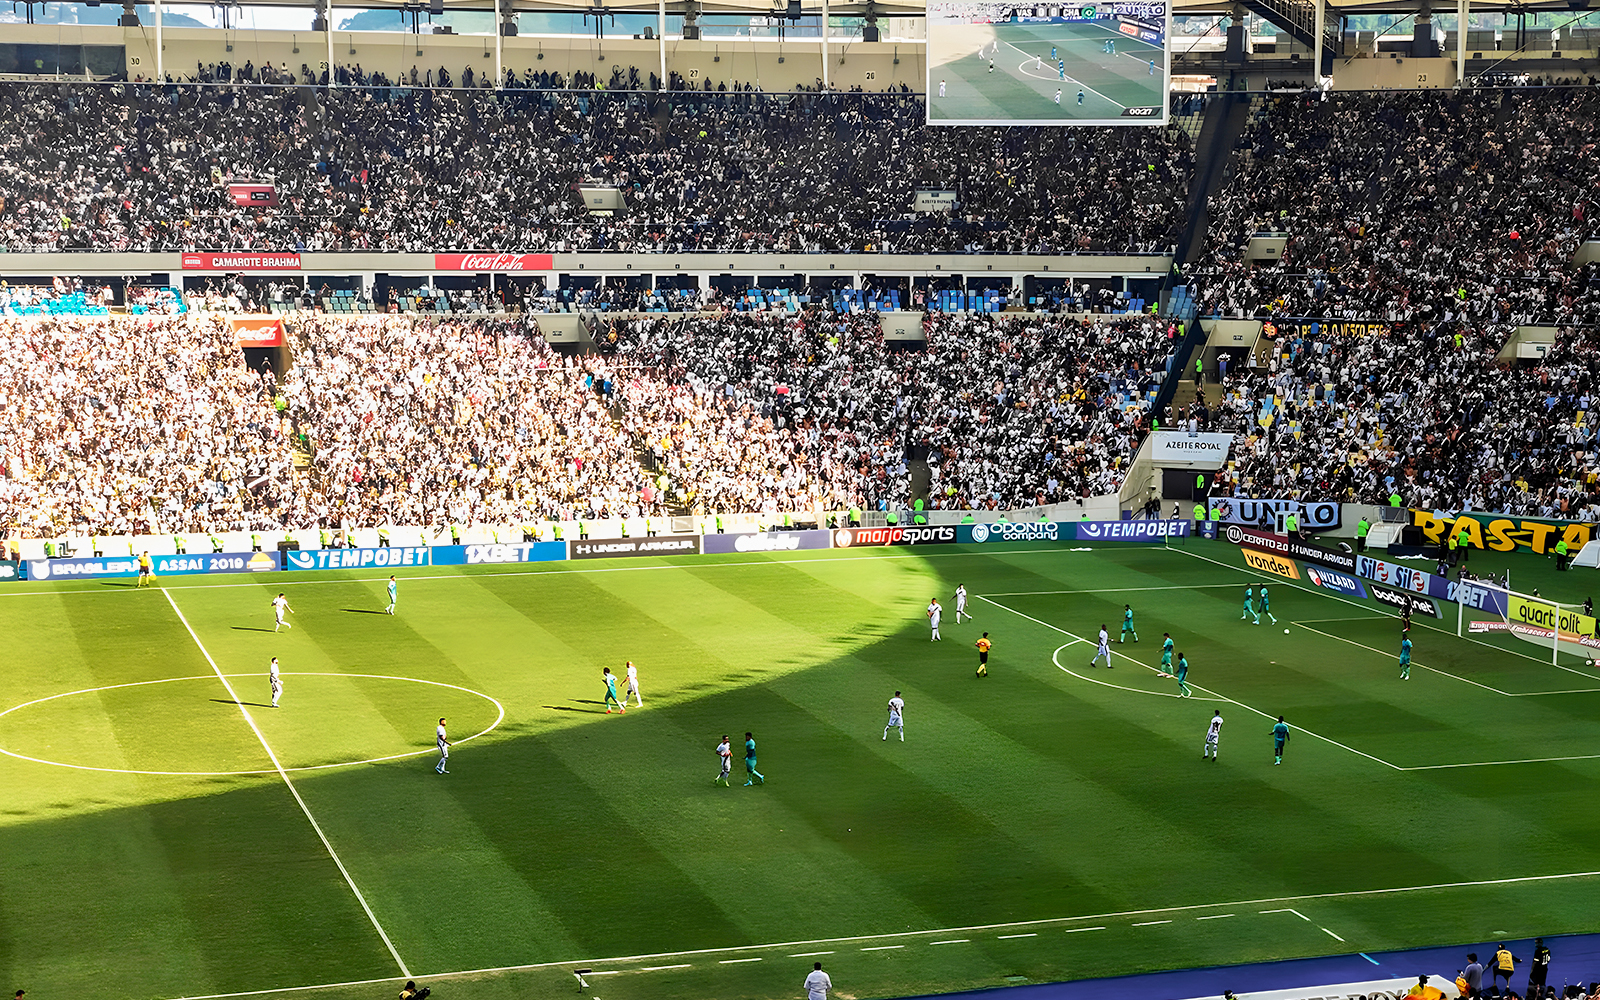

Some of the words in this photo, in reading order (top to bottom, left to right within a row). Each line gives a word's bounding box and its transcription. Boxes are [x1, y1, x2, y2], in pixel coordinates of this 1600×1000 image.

[1016, 8, 1033, 17] VAS
[1063, 8, 1080, 17] CHA
[130, 57, 140, 66] 30
[689, 69, 699, 78] 27
[1417, 74, 1427, 82] 23
[212, 257, 261, 267] CAMAROTE
[262, 257, 301, 267] BRAHMA
[1166, 441, 1193, 449] AZEITE
[1194, 442, 1221, 450] ROYAL
[990, 522, 1058, 533] ODONTO
[1103, 521, 1188, 537] TEMPOBET
[856, 526, 955, 546] marjosports
[1002, 531, 1058, 542] company
[1243, 534, 1276, 549] CERATO
[465, 542, 534, 564] 1XBET
[592, 542, 636, 553] UNDER
[638, 540, 695, 551] ARMOUR
[316, 547, 428, 568] TEMPOBET
[1299, 545, 1322, 559] UNDER
[1323, 551, 1354, 567] ARMOUR
[209, 557, 244, 570] 2019
[1246, 553, 1290, 577] vonder
[1315, 569, 1356, 591] WIZARD
[1447, 580, 1489, 609] 1XBET
[1519, 604, 1581, 635] quartolit
